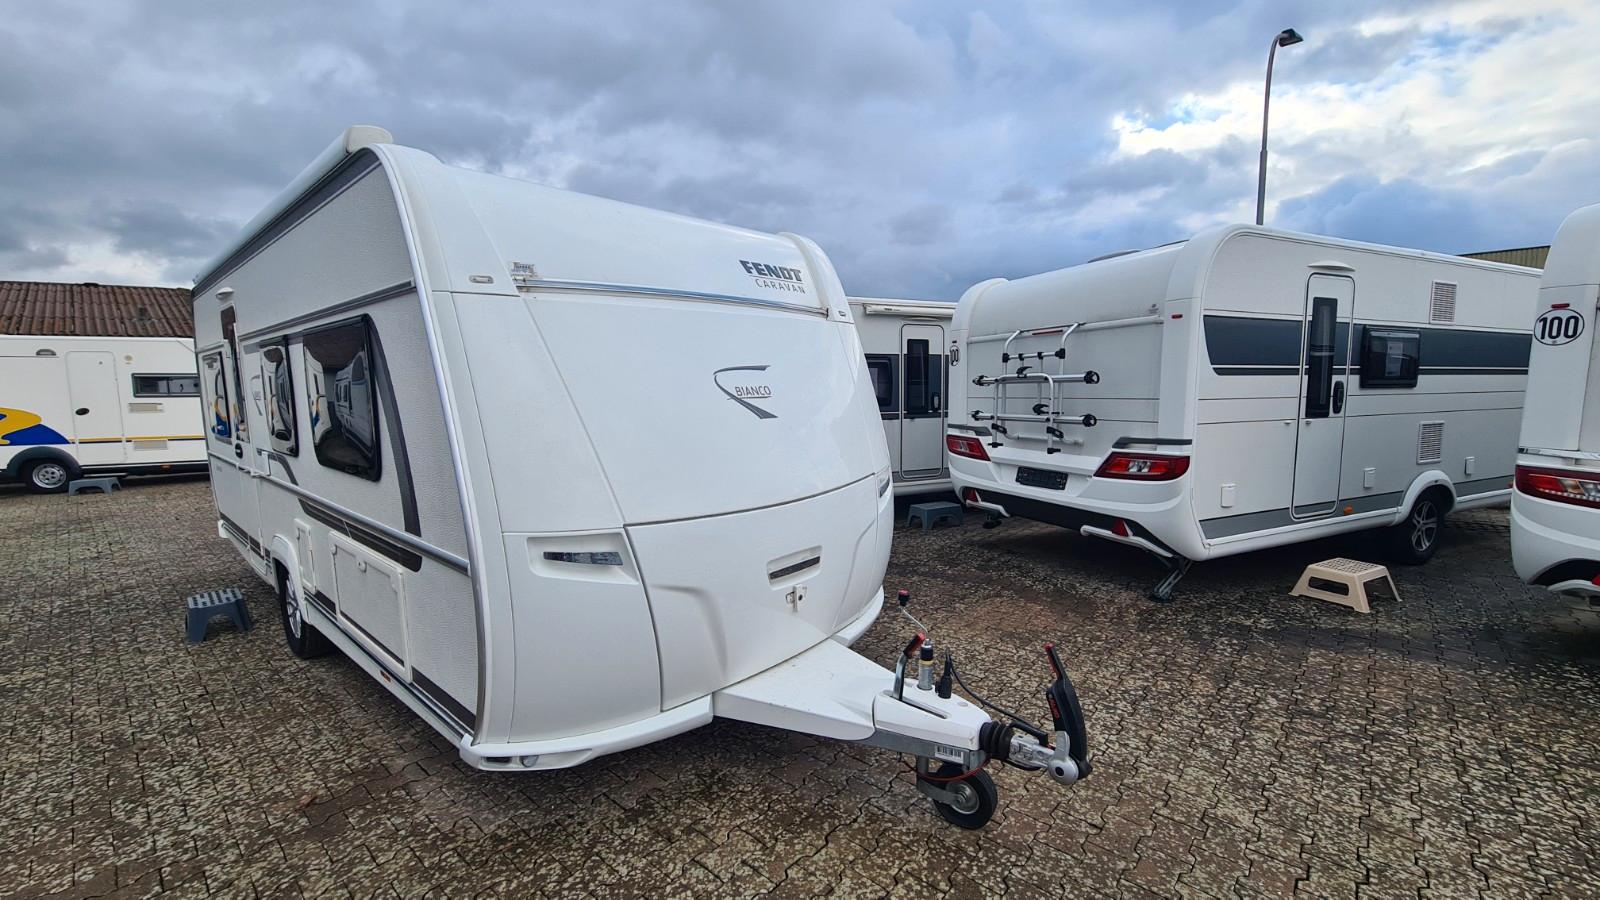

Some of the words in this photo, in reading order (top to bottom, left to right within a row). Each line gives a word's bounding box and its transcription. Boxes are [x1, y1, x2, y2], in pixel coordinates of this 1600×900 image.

[739, 259, 802, 282] FENDT
[755, 278, 806, 294] CARAVAN
[1538, 315, 1580, 340] 100
[735, 386, 771, 396] BIANCO
